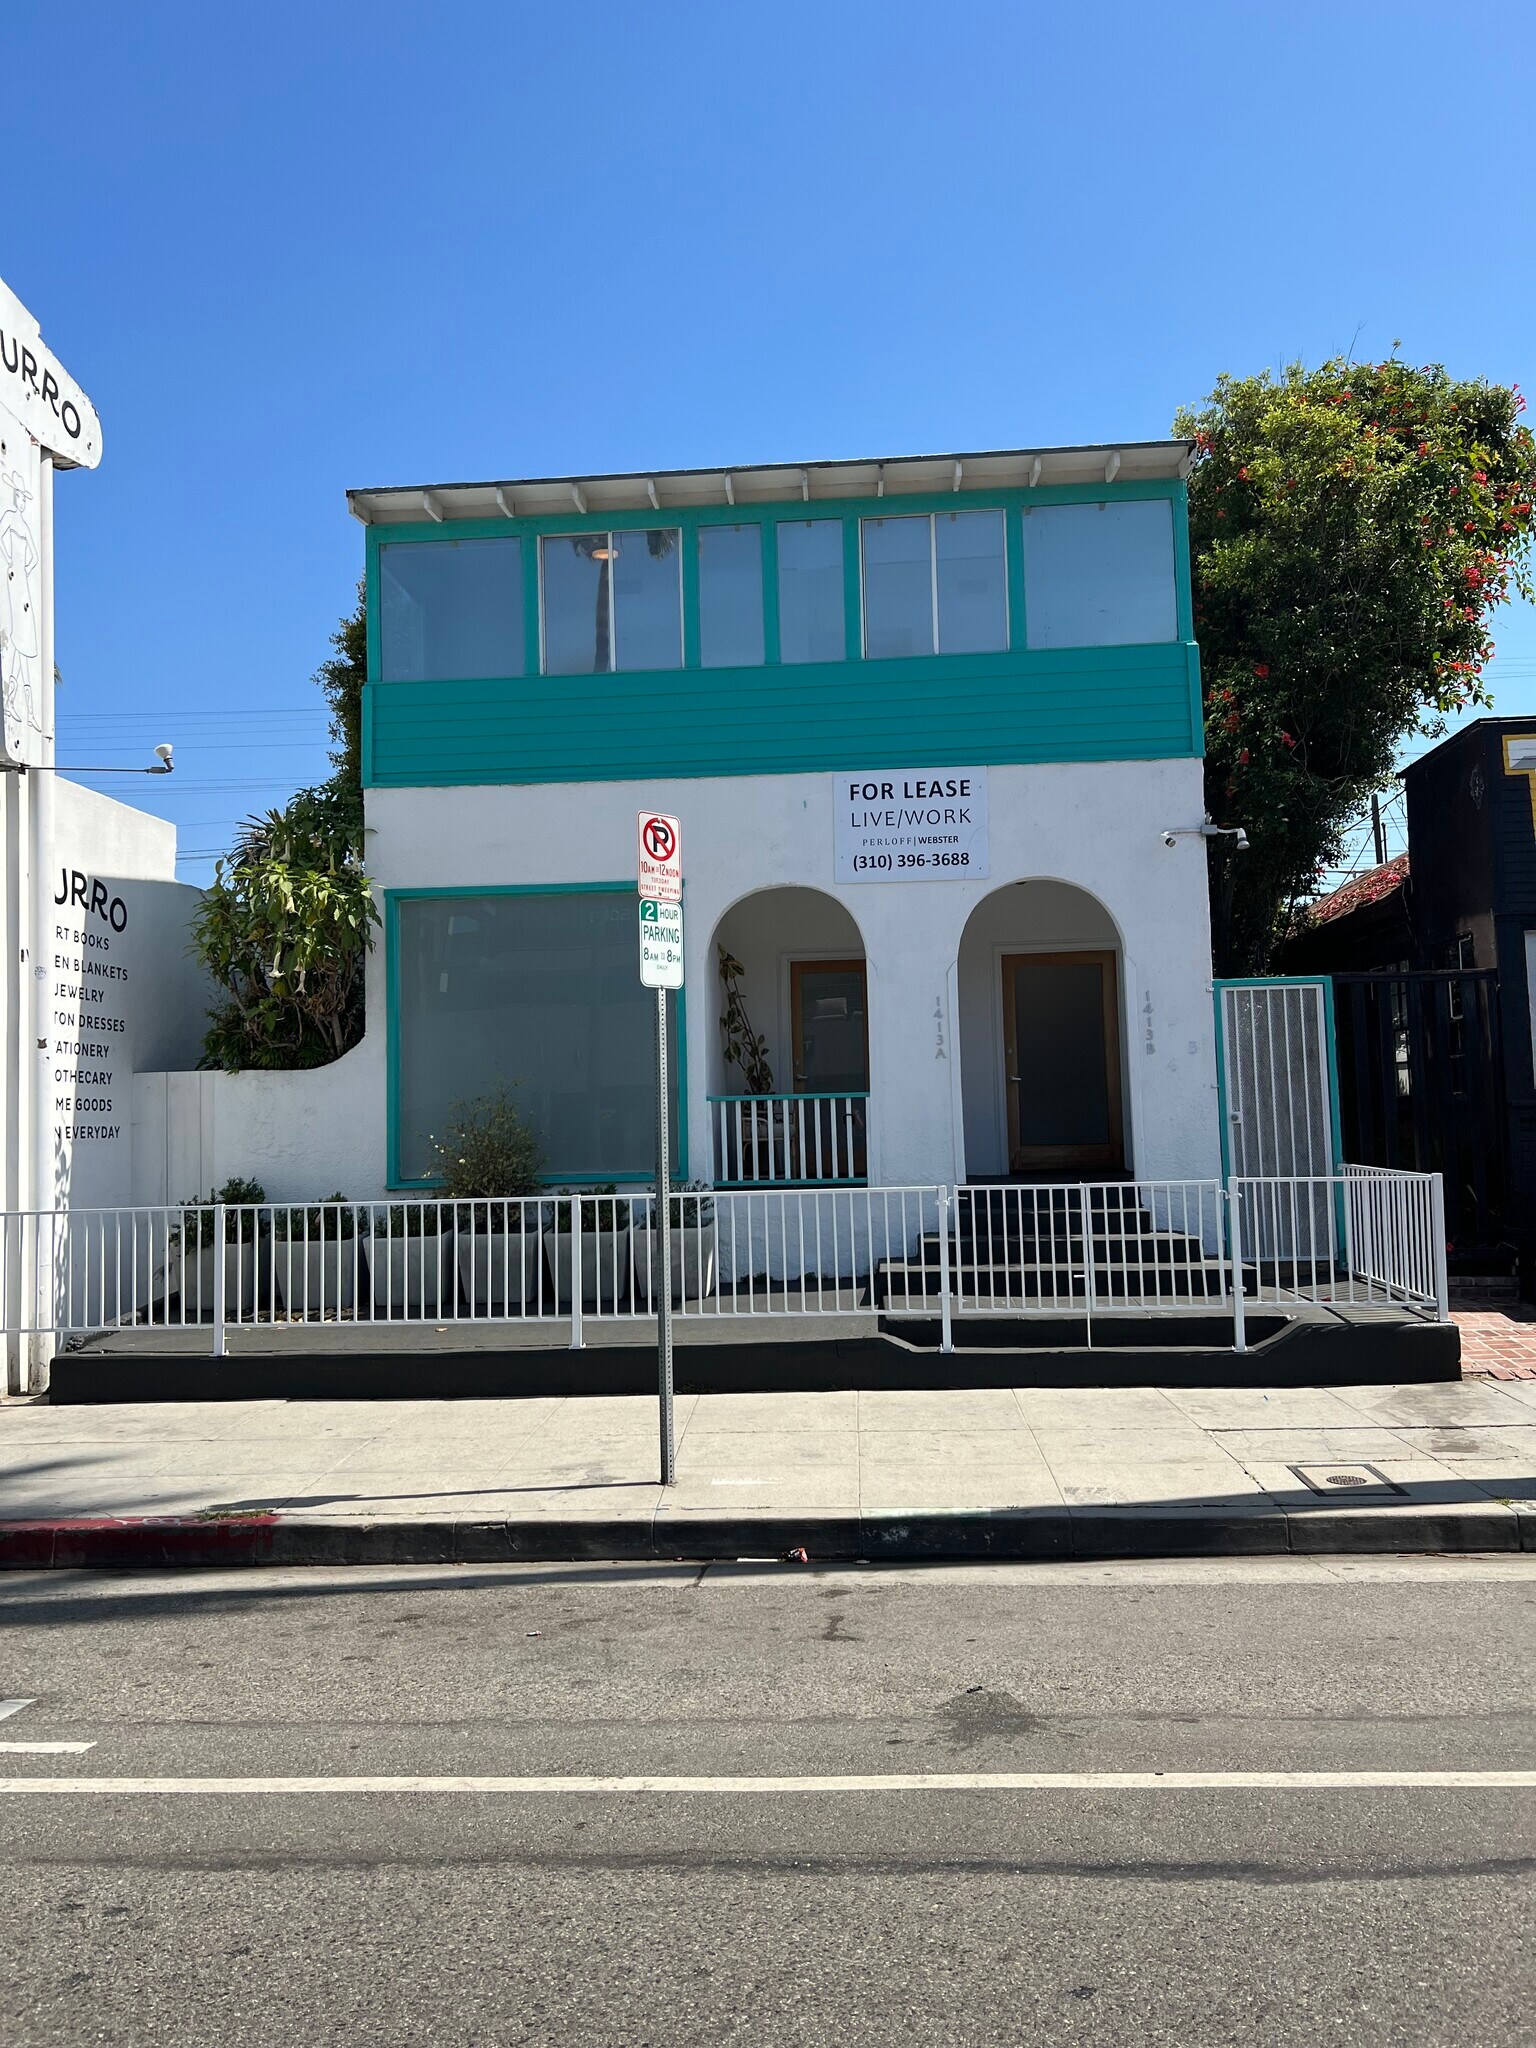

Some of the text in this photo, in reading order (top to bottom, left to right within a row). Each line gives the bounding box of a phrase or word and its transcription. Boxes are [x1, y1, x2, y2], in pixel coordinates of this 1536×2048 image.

[850, 779, 971, 801] FOR LEASE
[851, 808, 972, 829] LIVE/WORK
[641, 861, 655, 874] 10AM
[659, 864, 679, 877] 12NOON
[853, 852, 970, 872] (310) 396-3688
[658, 886, 680, 895] SWEEPING
[645, 902, 679, 920] 2 HOUR
[74, 930, 110, 951] BOOKS
[643, 925, 680, 944] PARKING
[643, 947, 659, 961] 8AM
[666, 949, 681, 963] 8PM
[74, 959, 129, 981] BLANKETS
[54, 982, 105, 1003] JEWELRY
[79, 1014, 126, 1033] DRESSES
[54, 1069, 113, 1085] OTHECARY
[56, 1097, 113, 1112] ME GOODS
[65, 1125, 120, 1139] EVERYDAY
